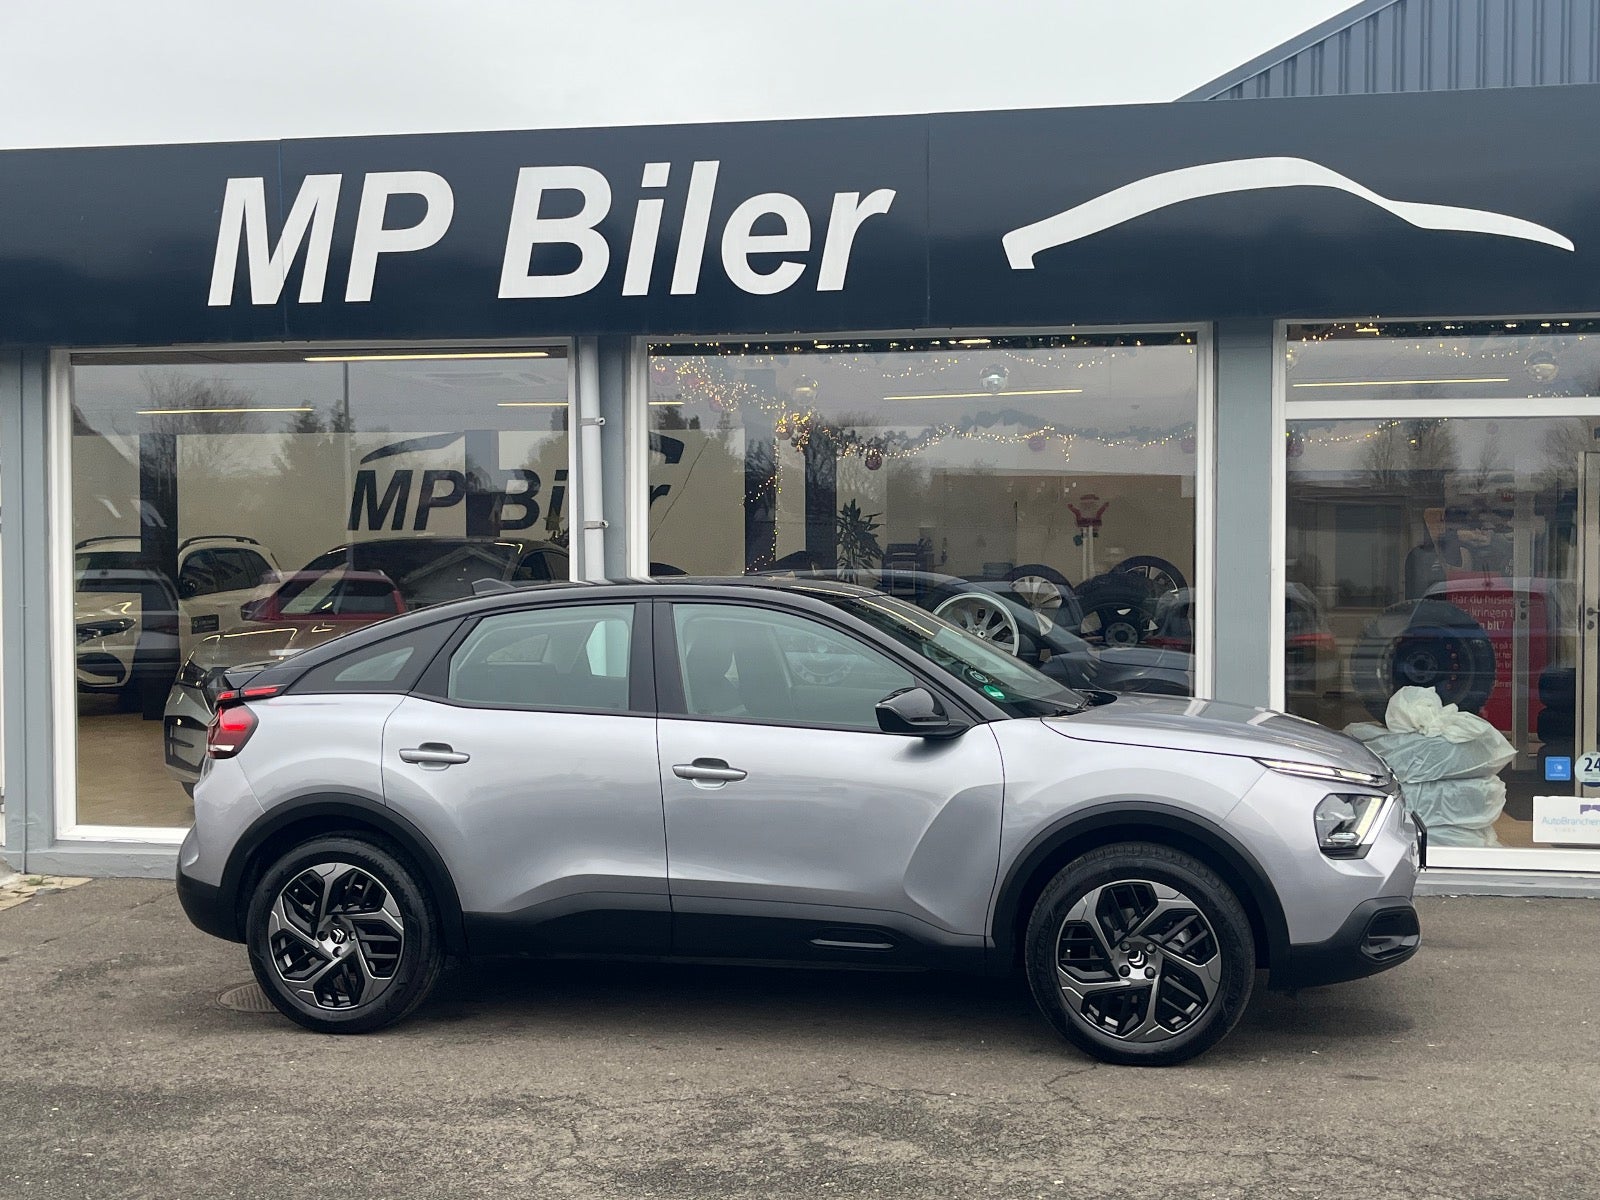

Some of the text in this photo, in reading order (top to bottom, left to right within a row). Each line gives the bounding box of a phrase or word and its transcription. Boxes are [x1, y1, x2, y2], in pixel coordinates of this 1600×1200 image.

[207, 160, 897, 307] MP Biler
[348, 469, 465, 531] MP
